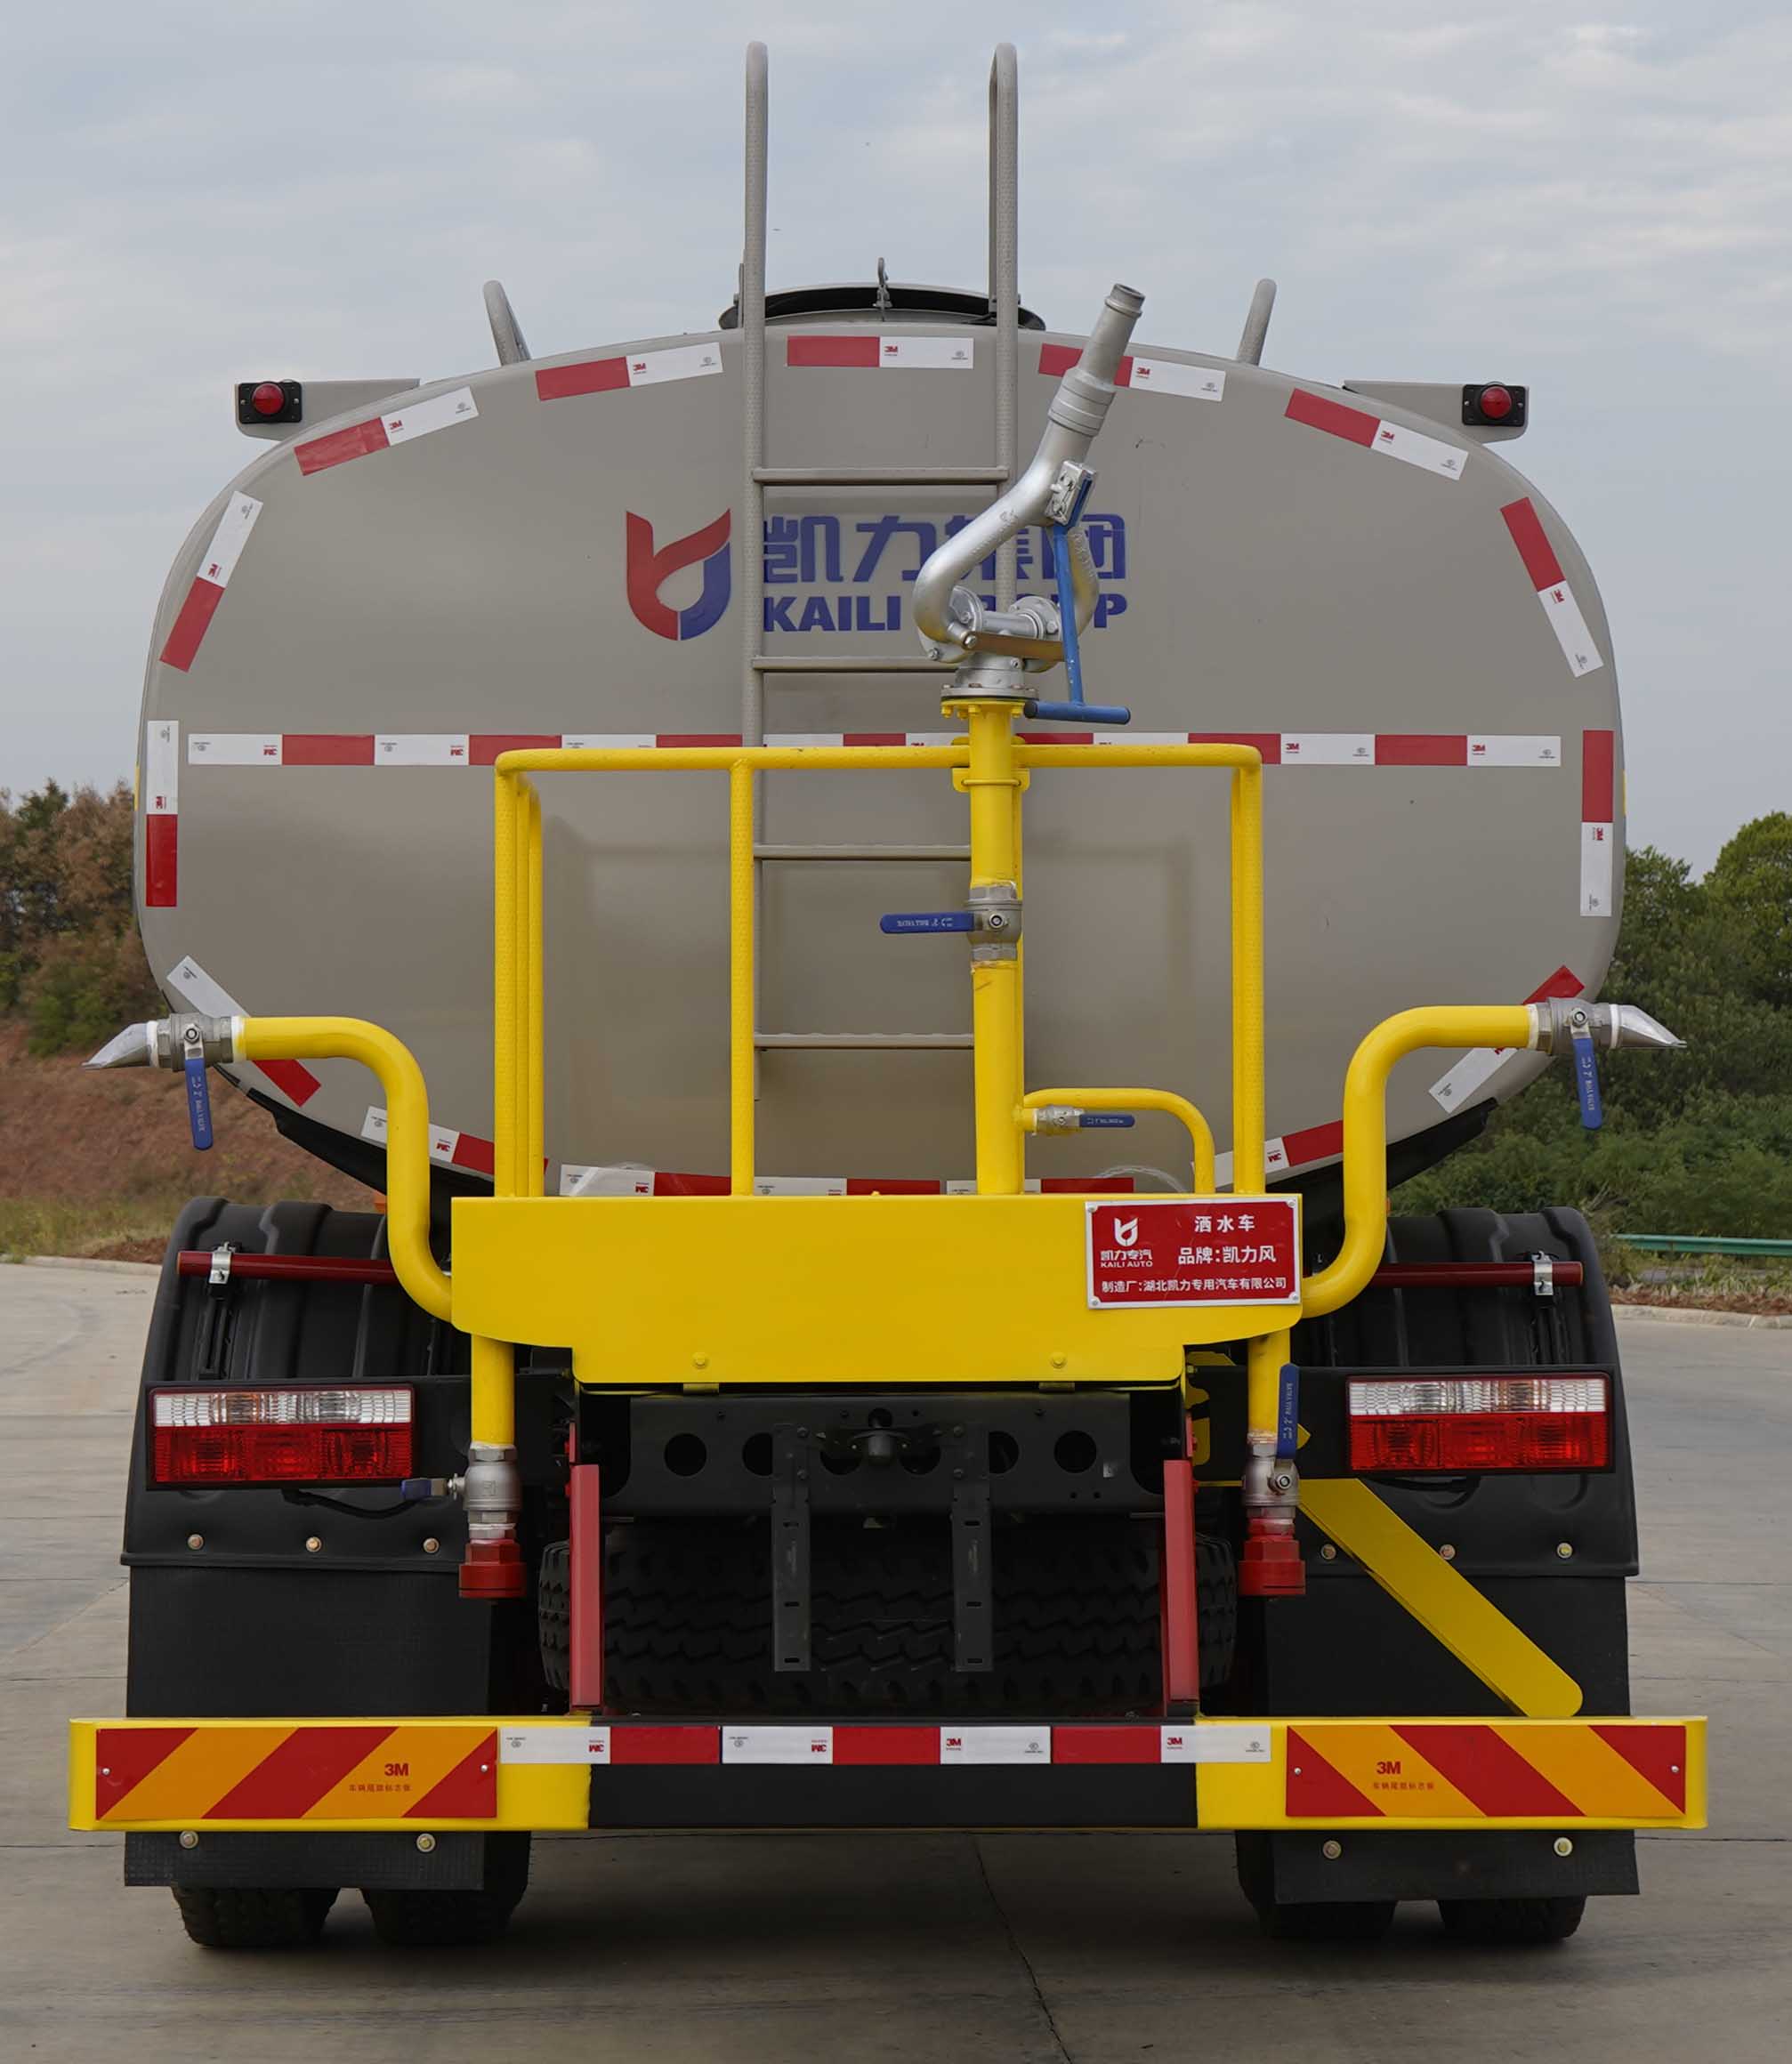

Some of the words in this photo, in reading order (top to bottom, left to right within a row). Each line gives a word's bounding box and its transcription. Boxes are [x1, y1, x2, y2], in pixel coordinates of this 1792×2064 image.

[763, 595, 900, 633] KAILI
[1194, 1214, 1255, 1233] 洒水车
[1177, 1245, 1277, 1265] 品牌:凯力风
[946, 1737, 962, 1746] 3M
[1167, 1737, 1183, 1746] 3M
[384, 1763, 408, 1777] 3M
[1376, 1762, 1401, 1774] 3M
